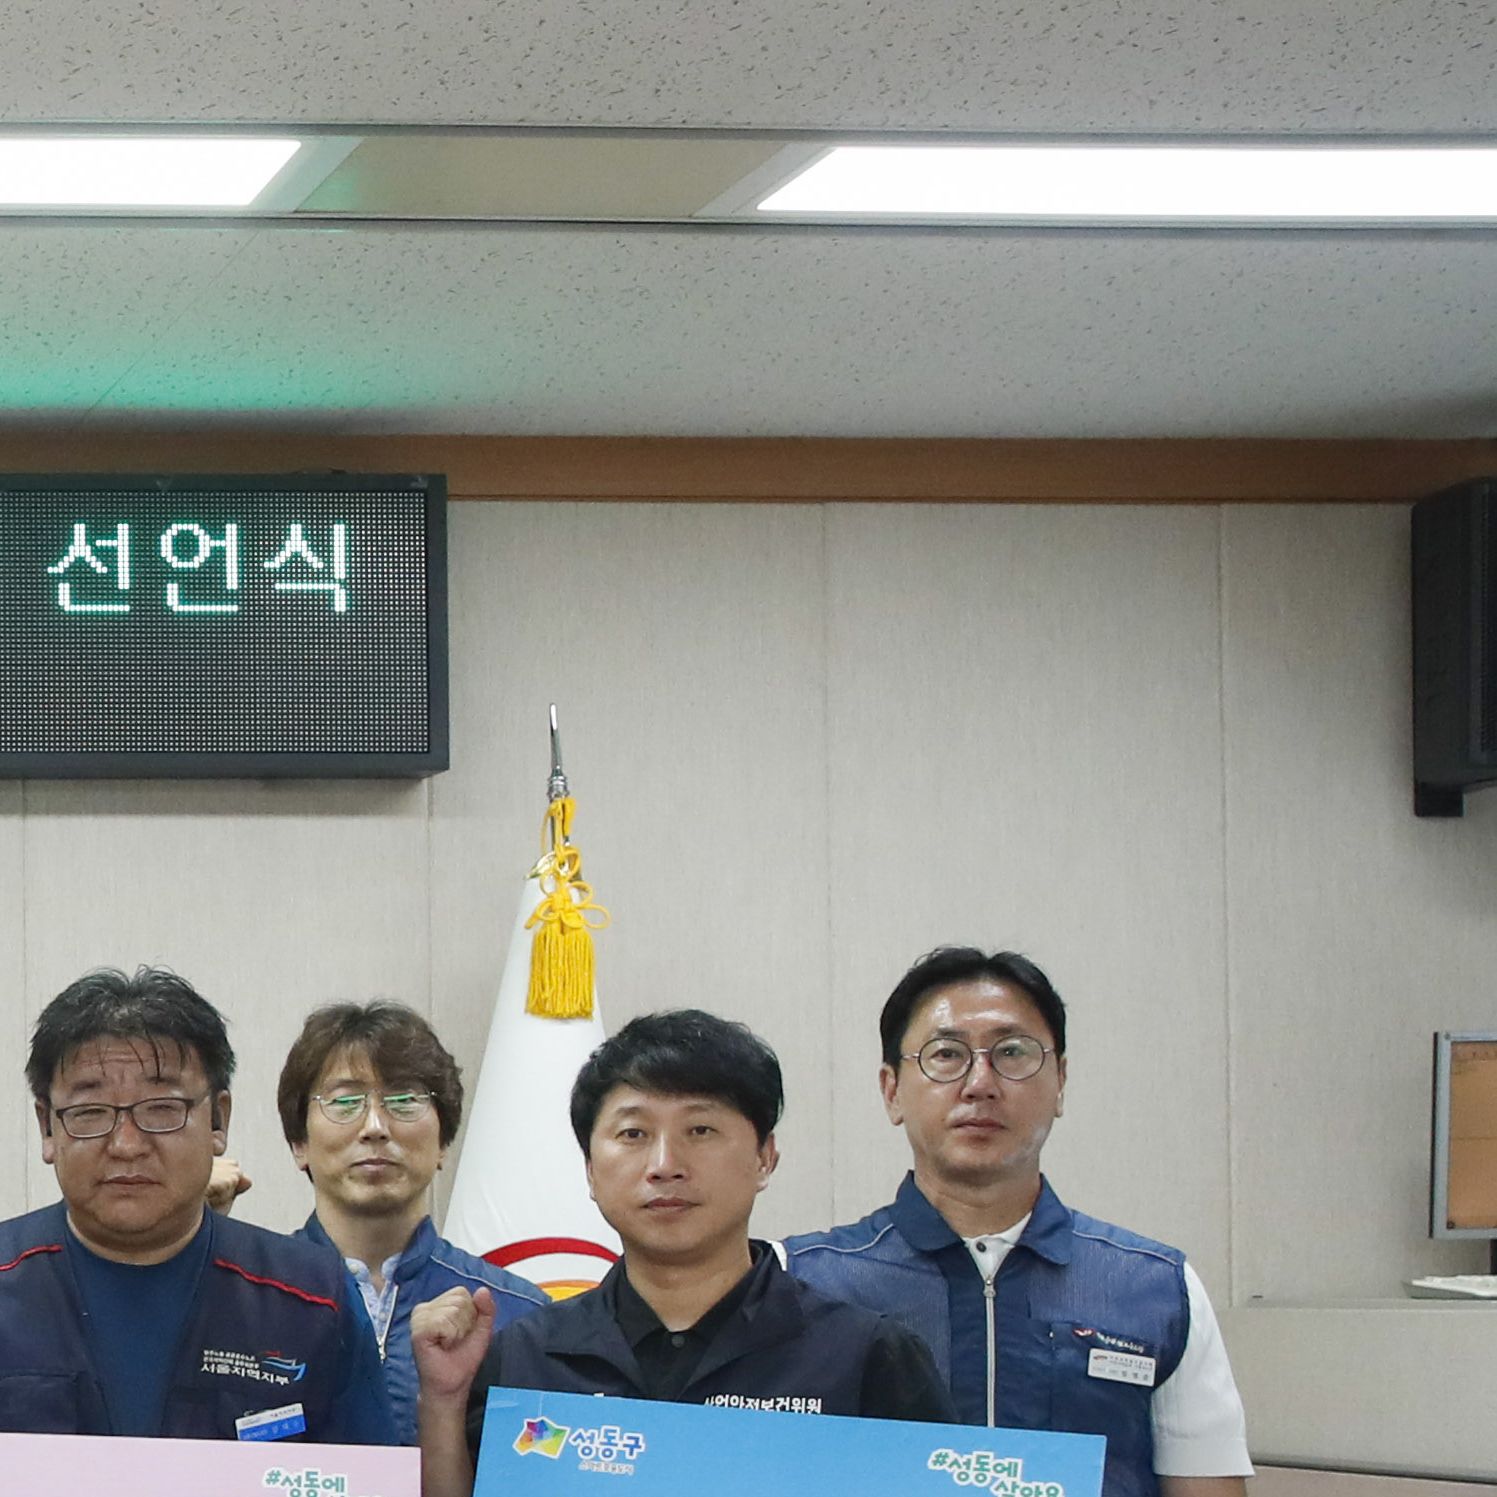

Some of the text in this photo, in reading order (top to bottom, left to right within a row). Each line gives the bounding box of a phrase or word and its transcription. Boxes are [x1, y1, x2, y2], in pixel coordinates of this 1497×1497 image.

[46, 520, 349, 615] 선언식
[201, 1363, 290, 1386] 서울지역지부
[572, 1428, 642, 1459] 성동구
[931, 1451, 1019, 1483] #성동에
